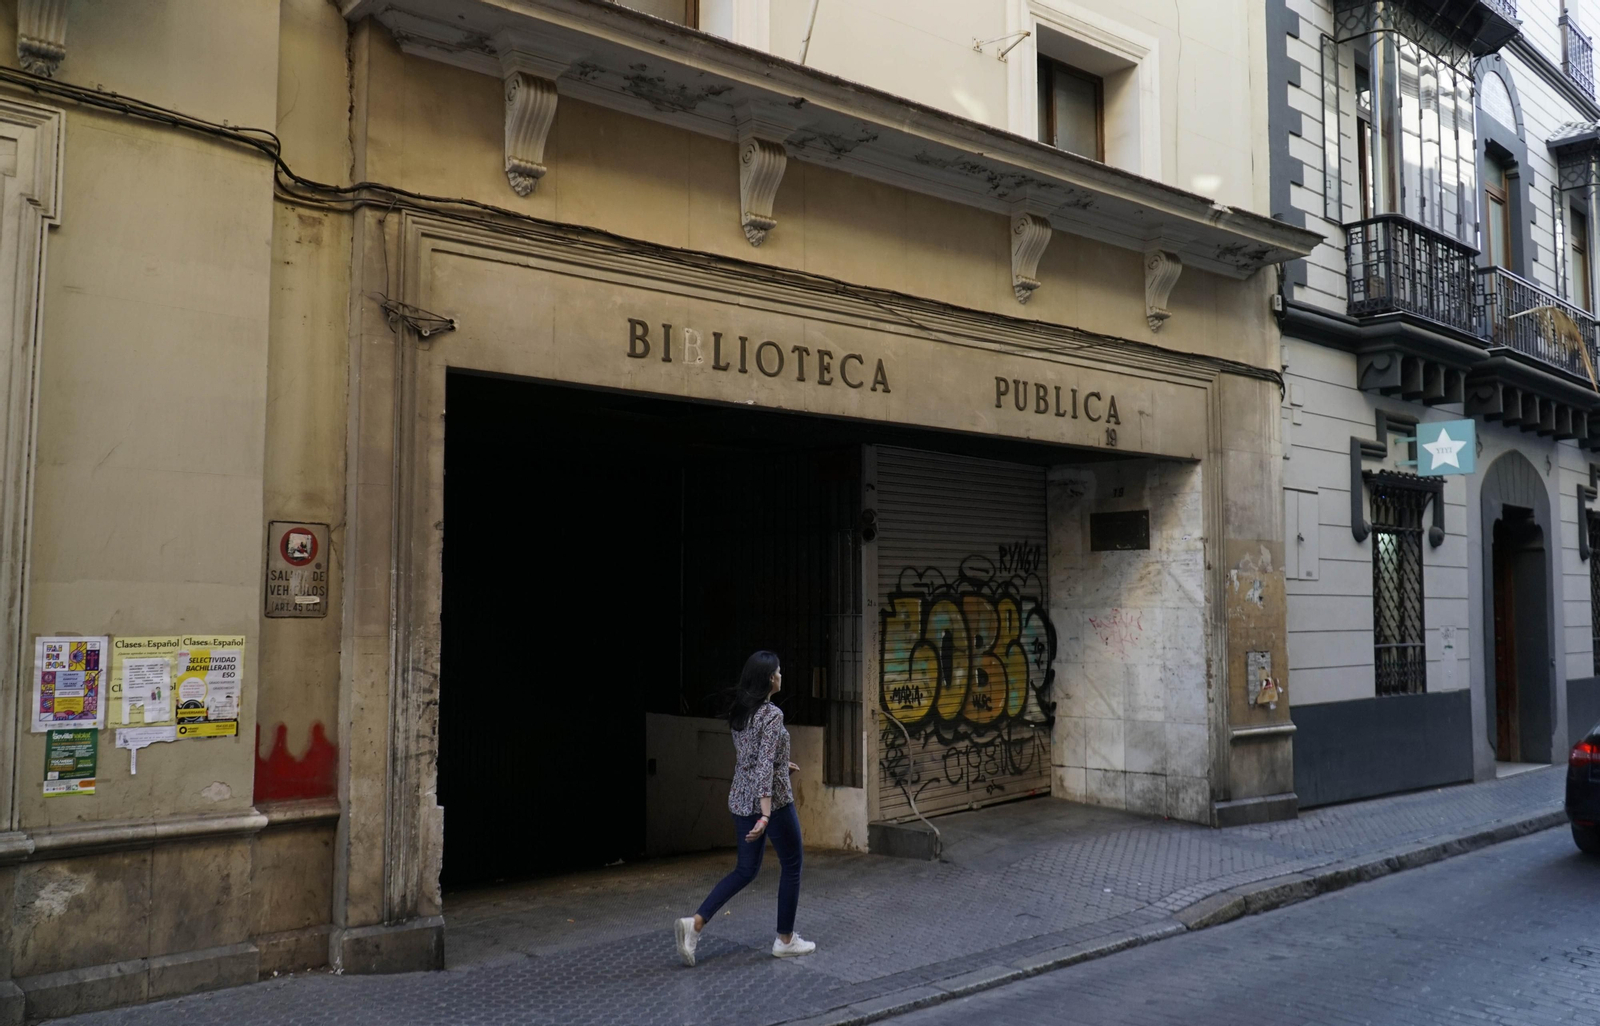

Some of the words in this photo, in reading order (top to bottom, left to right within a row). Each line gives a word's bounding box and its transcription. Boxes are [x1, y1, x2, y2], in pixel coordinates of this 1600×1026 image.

[627, 317, 891, 394] BIBLIOTECA
[995, 376, 1121, 425] PUBLICA
[1105, 427, 1117, 447] 19
[313, 571, 325, 582] DE
[115, 640, 142, 648] Clases
[147, 639, 179, 650] Español
[183, 638, 208, 646] Clases
[213, 638, 243, 648] Español
